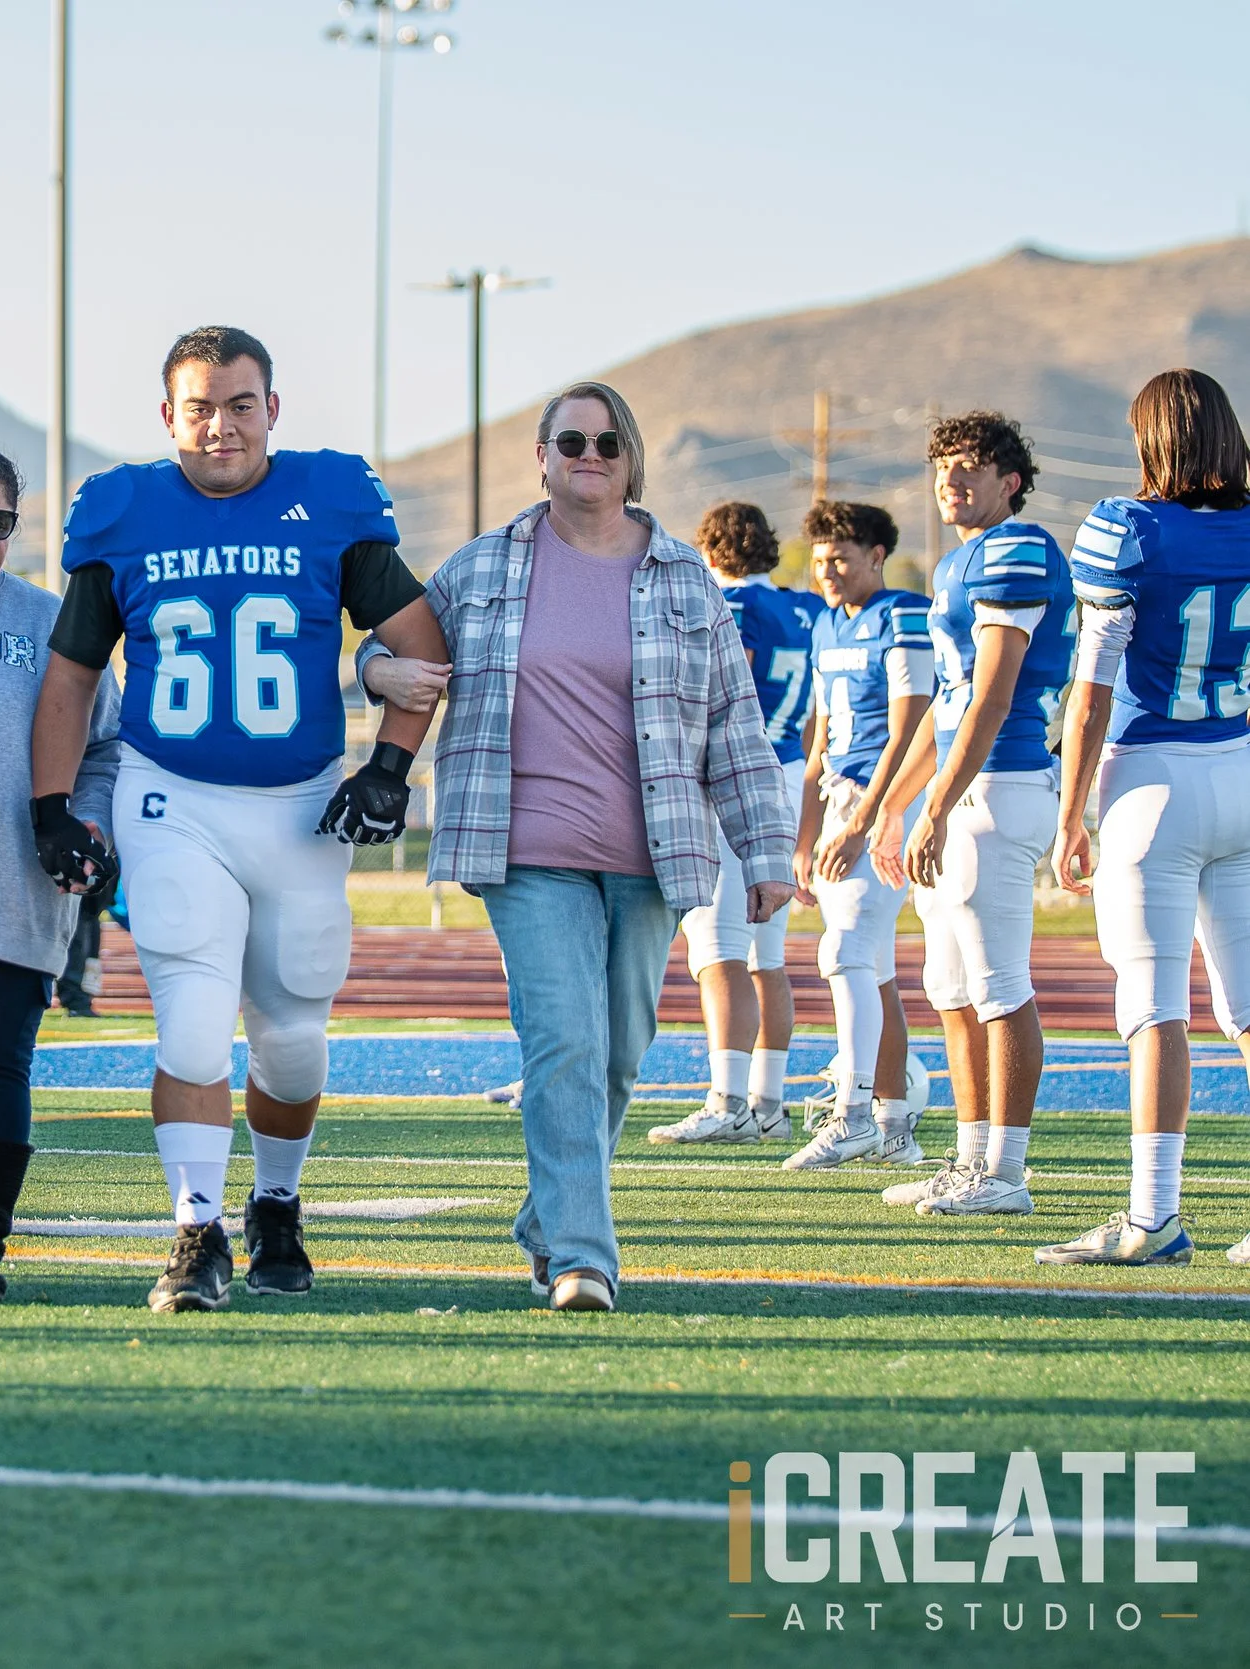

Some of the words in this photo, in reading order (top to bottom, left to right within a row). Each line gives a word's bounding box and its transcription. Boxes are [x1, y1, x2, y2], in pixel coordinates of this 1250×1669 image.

[144, 545, 301, 583] SENATORS
[149, 593, 301, 738] 66
[141, 792, 167, 818] C
